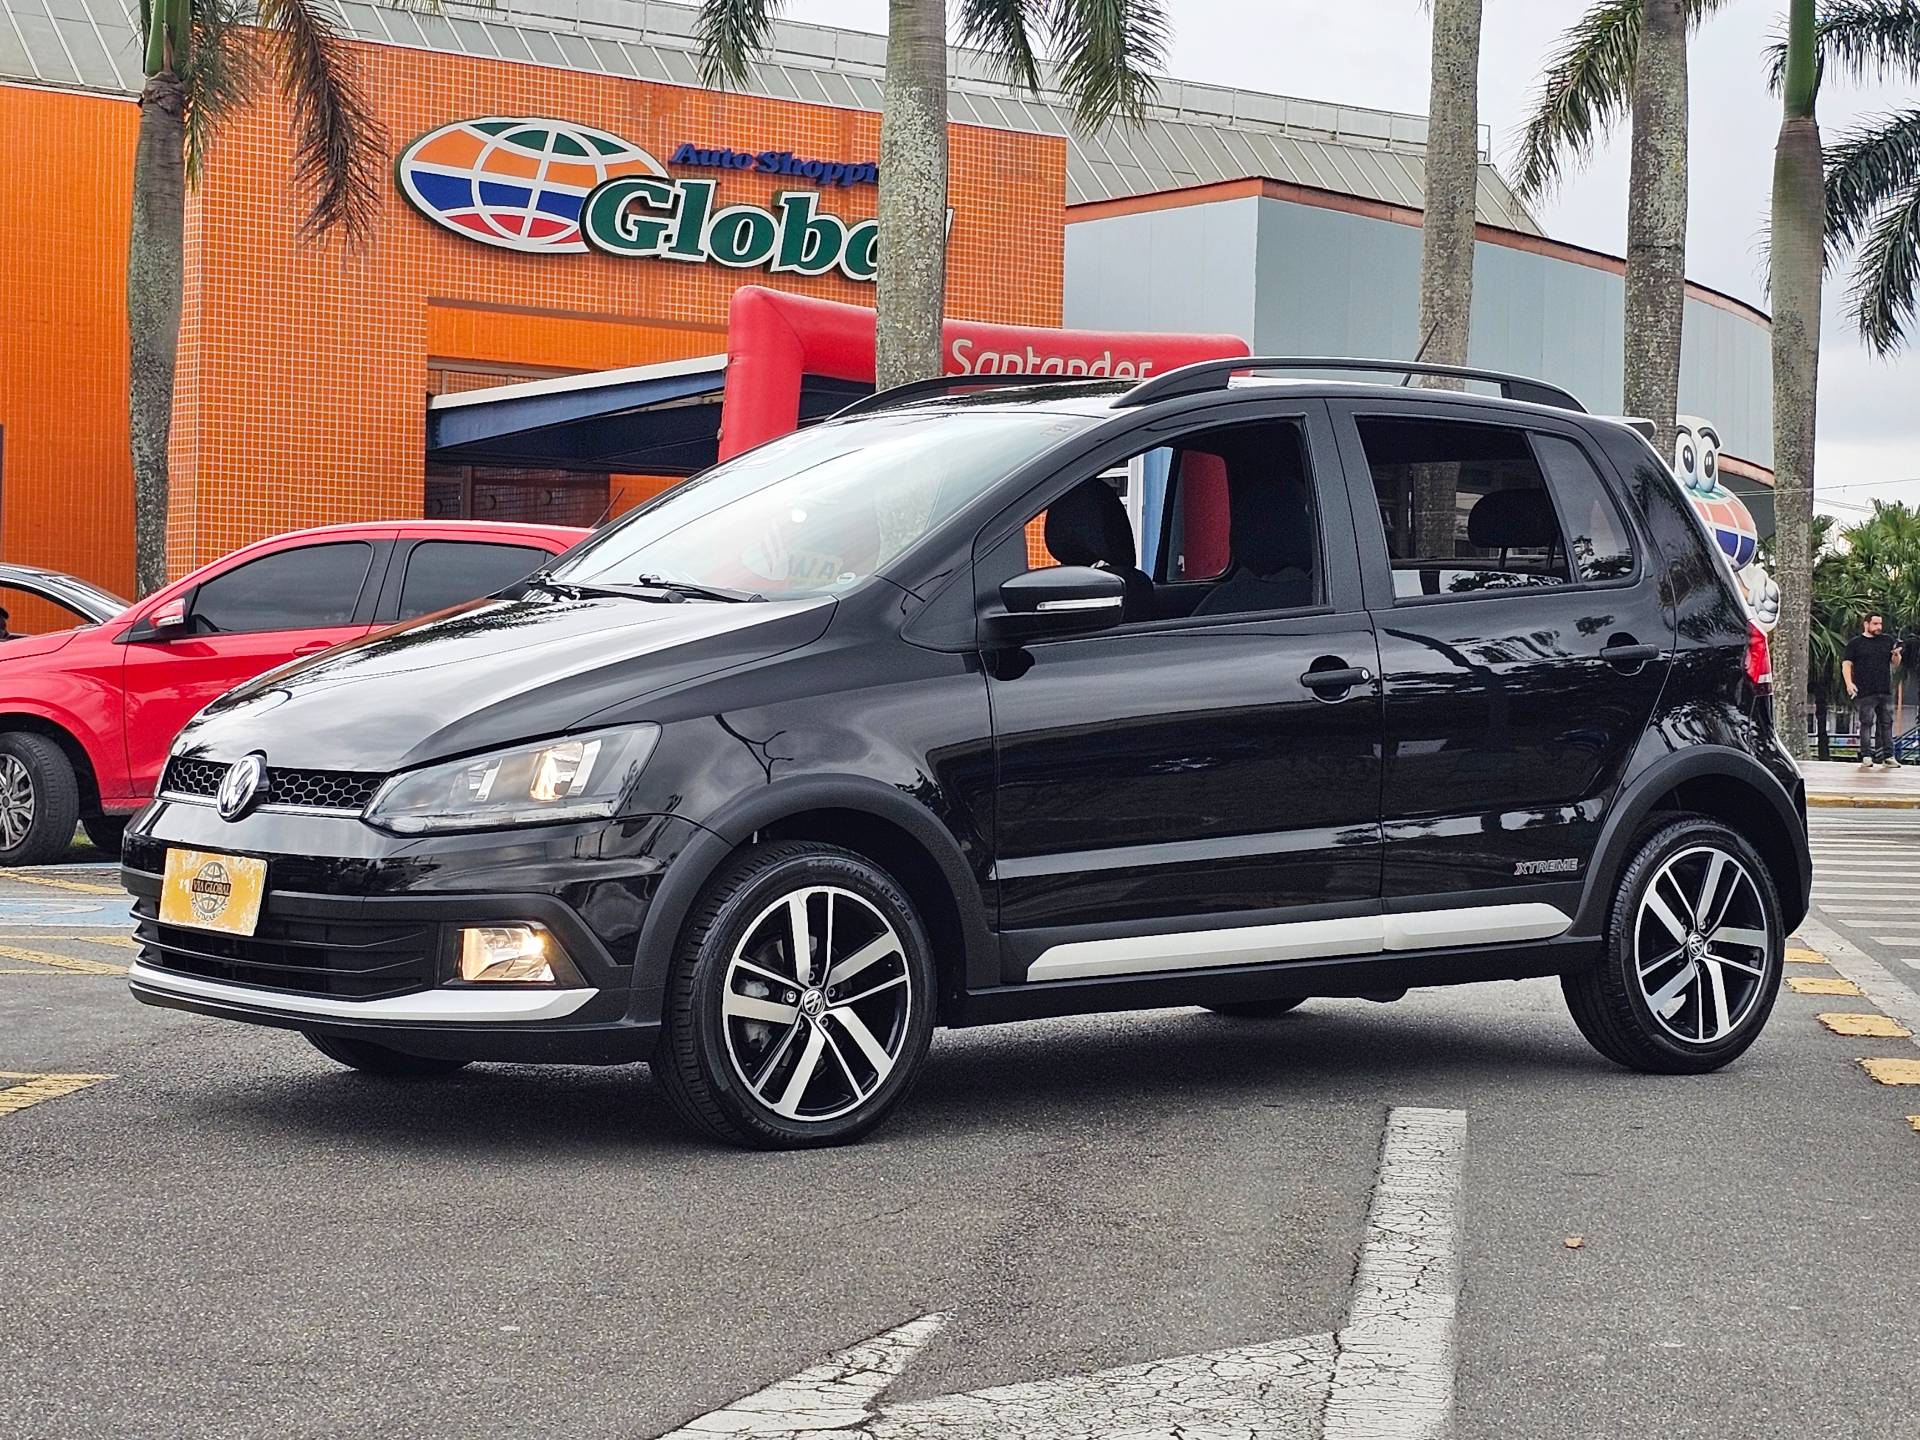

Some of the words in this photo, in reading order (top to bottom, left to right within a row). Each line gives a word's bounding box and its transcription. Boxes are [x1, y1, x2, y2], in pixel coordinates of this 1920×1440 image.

[668, 143, 752, 170] Auto
[754, 151, 879, 187] Shoppi
[580, 178, 952, 282] Globa
[948, 338, 1153, 381] Santander
[193, 880, 204, 892] VIA
[205, 881, 230, 895] GLOBAL
[1513, 858, 1578, 876] XTREME
